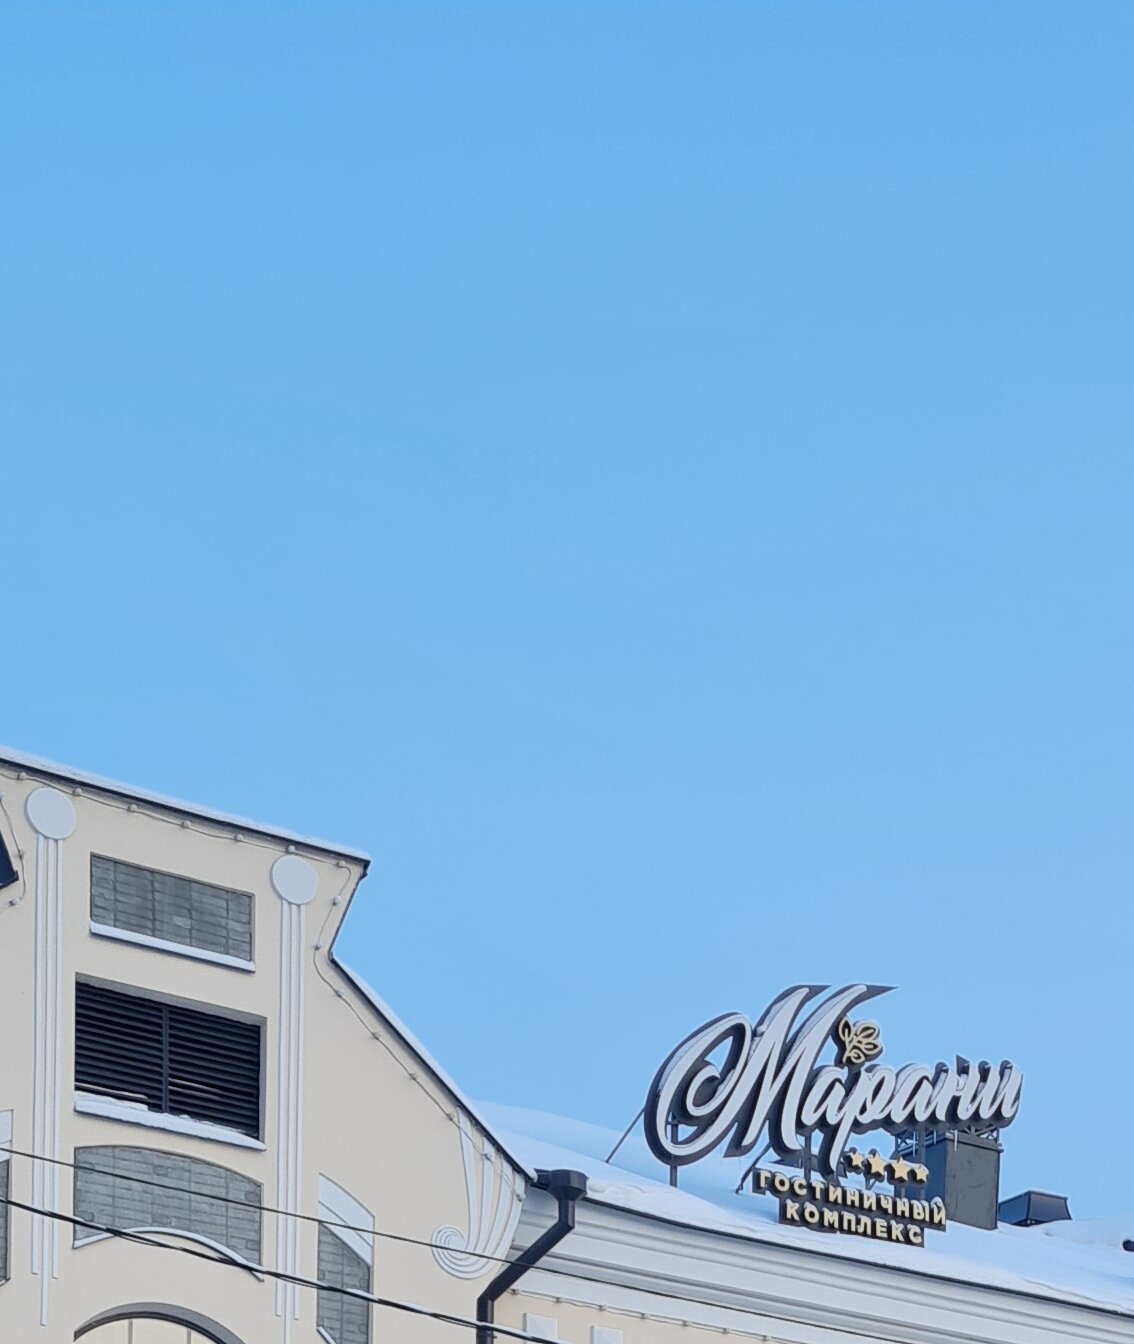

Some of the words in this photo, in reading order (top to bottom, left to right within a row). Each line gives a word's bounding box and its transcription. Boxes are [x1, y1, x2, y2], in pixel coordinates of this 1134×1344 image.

[644, 983, 1023, 1181] Марани
[756, 1169, 946, 1226] ГОСТИНИЧНЫЙ
[784, 1199, 924, 1245] КОМПЛЕКС
